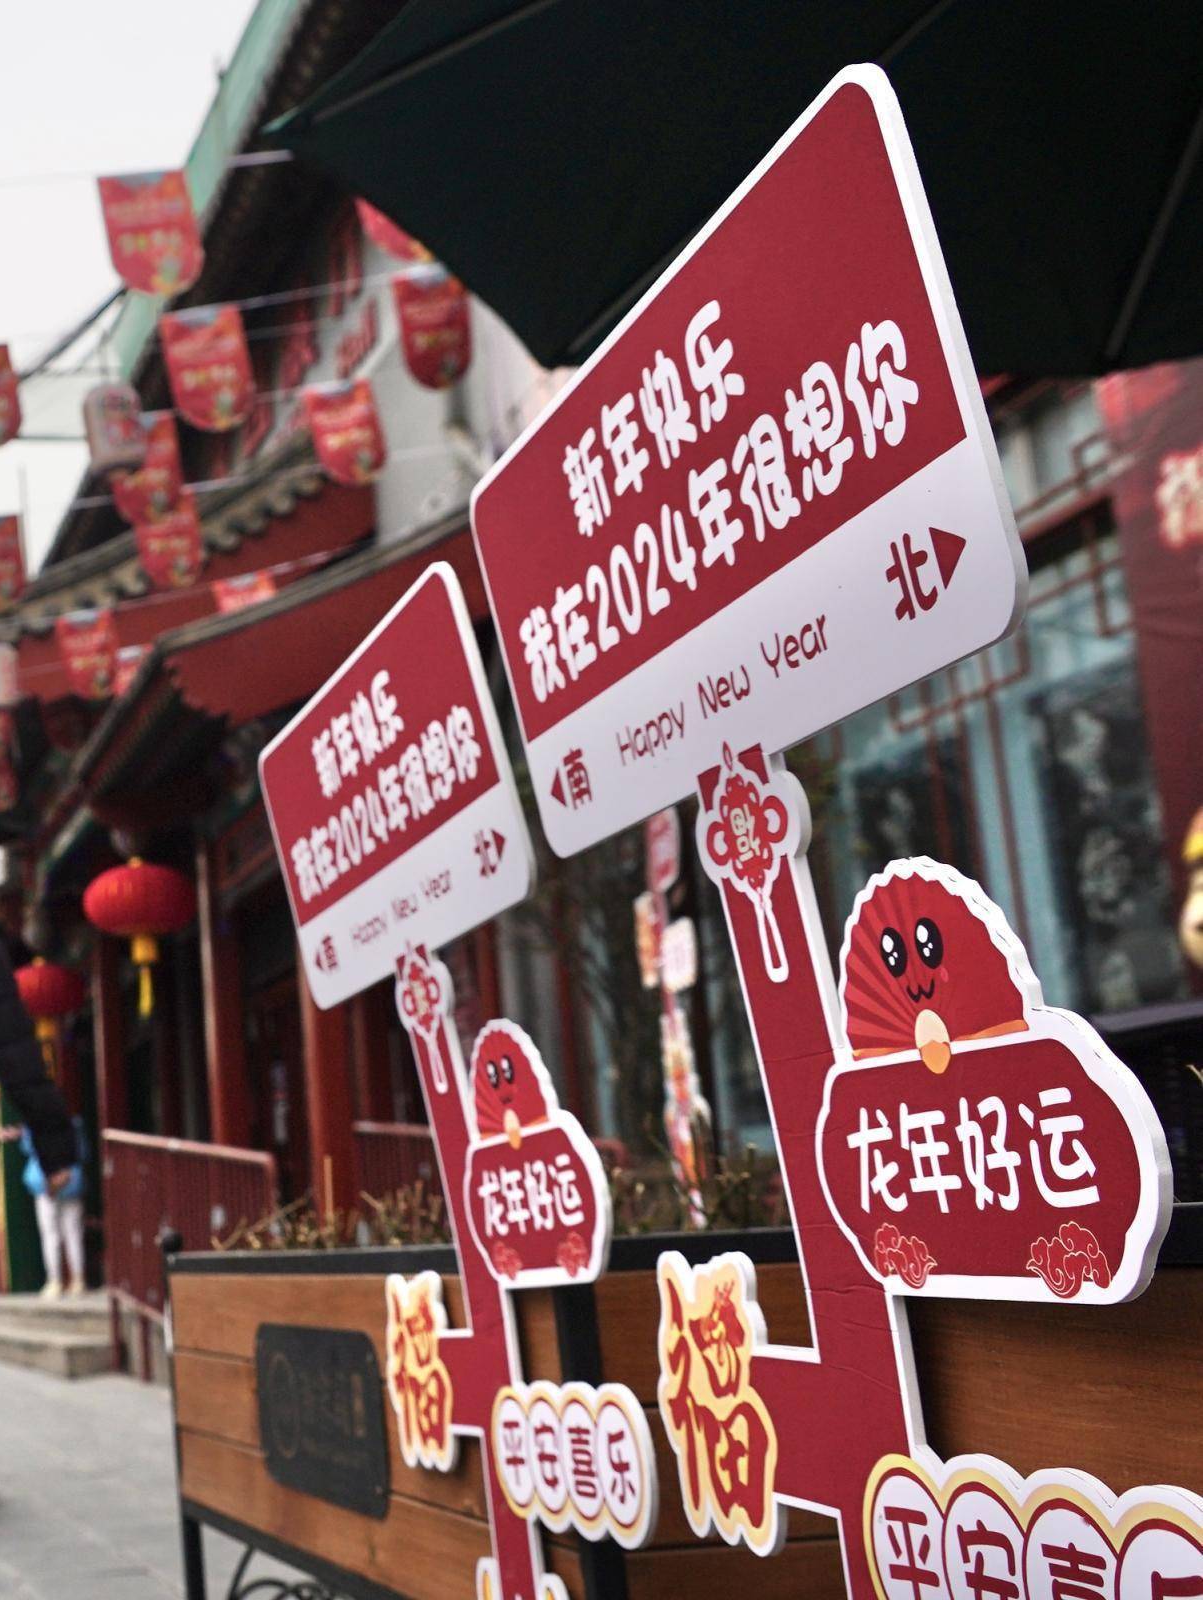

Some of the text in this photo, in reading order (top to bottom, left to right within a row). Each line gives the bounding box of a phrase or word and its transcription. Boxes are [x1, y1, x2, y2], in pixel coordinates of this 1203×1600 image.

[562, 300, 745, 537] 新年快乐
[519, 319, 919, 702] 我在2024年很想你
[885, 532, 939, 622] 北
[312, 670, 405, 798] 新年快乐
[616, 613, 829, 766] Happy New Year
[291, 705, 482, 902] 我在2024年很想你
[563, 748, 593, 811] 南
[474, 829, 498, 878] 北
[478, 1154, 585, 1237] 龙年好运
[846, 1086, 1101, 1214] 龙年好运
[502, 1421, 634, 1504] 平安喜乐
